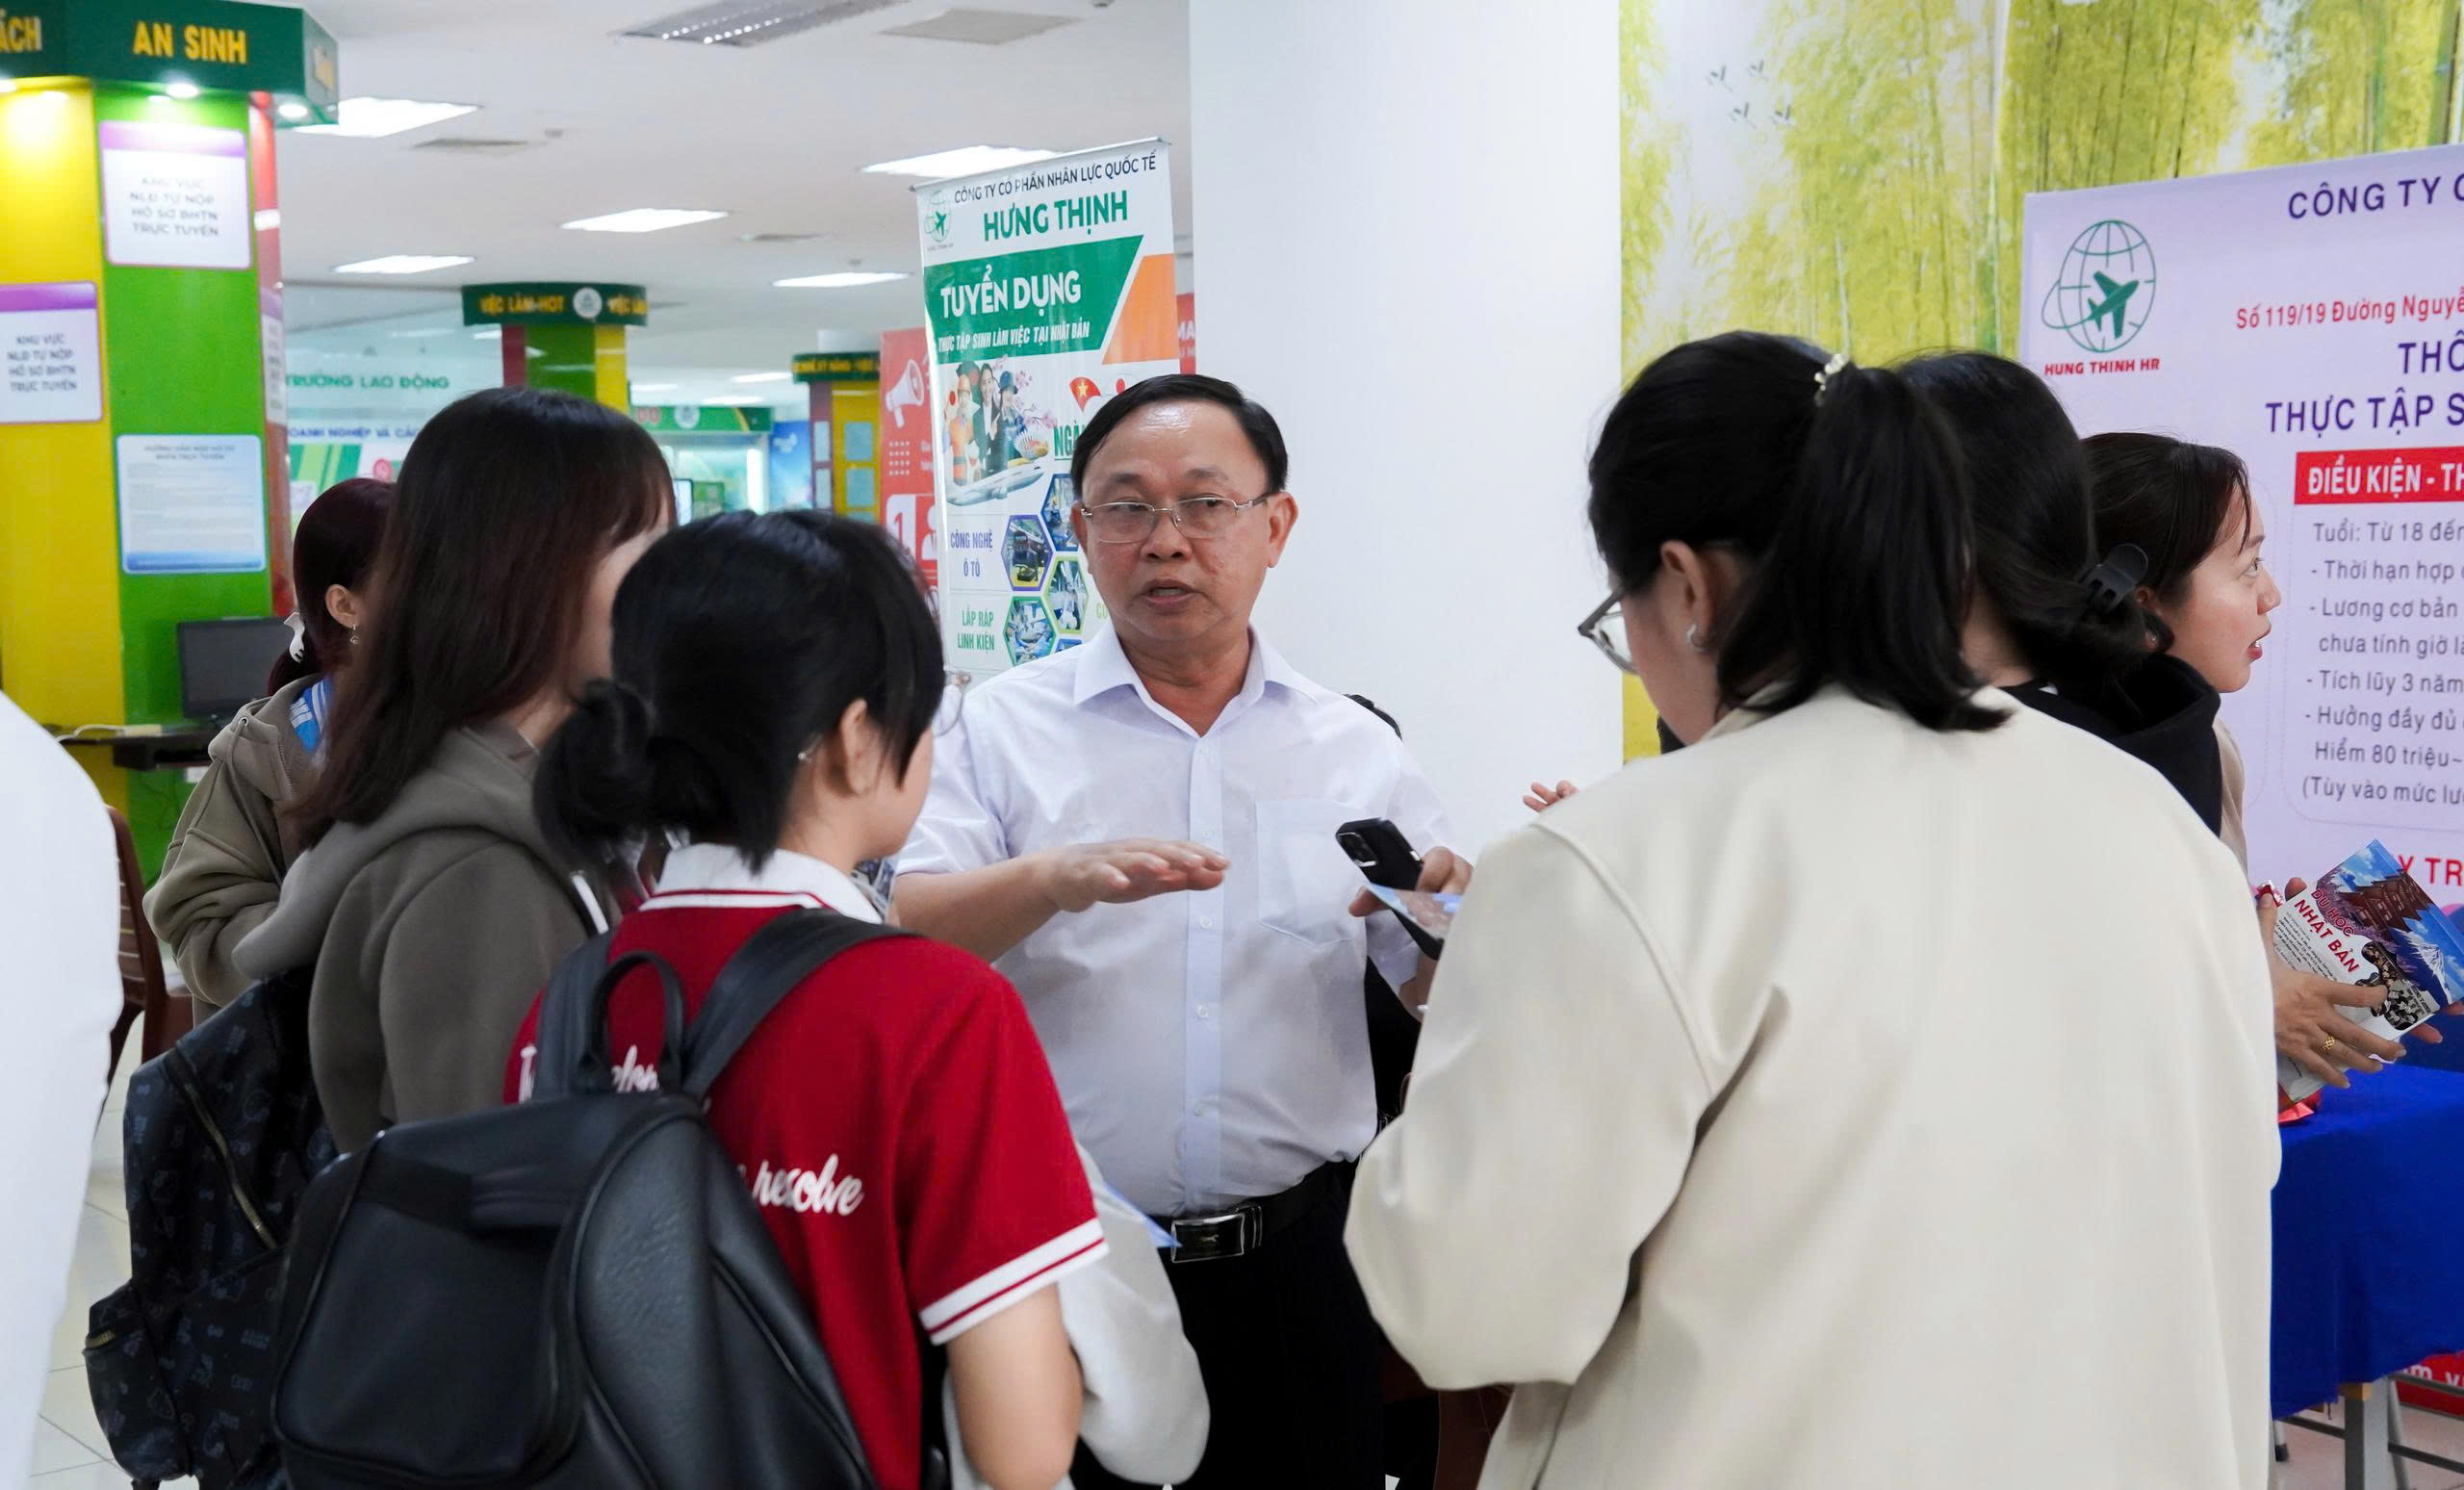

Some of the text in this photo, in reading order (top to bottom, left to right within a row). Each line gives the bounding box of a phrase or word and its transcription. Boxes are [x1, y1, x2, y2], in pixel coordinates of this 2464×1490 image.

[133, 19, 247, 64] AN SINH
[954, 185, 982, 204] CÔNG
[984, 184, 996, 198] TY
[1047, 166, 1078, 188] NHÂN
[1081, 163, 1103, 185] LỰC
[1105, 154, 1140, 179] QUỐC
[1142, 149, 1156, 170] TẾ
[2288, 181, 2385, 219] CÔNG
[2398, 176, 2442, 207] TY
[984, 190, 1128, 242] HƯNG THỊNH
[940, 263, 1081, 319] TUYỂN DỤNG
[2236, 303, 2261, 330] Số
[2266, 302, 2326, 327] 119/19
[2331, 297, 2397, 324] Đường
[956, 331, 971, 352] TẬP
[972, 331, 991, 348] SINH
[992, 327, 1008, 347] LÀM
[1010, 324, 1030, 347] VIỆC
[1033, 325, 1048, 347] TẠI
[1050, 321, 1070, 345] NHẬT
[1071, 317, 1091, 338] BẢN
[2398, 329, 2464, 374] THÔ
[2044, 357, 2161, 376] HUNG THINH HR
[361, 374, 394, 389] LAO
[399, 371, 450, 393] ĐỘNG
[2265, 395, 2355, 439] THỰC
[2367, 387, 2434, 436] TẬP
[288, 426, 324, 439] OANH
[1053, 419, 1085, 456] NGÀ
[2366, 456, 2423, 500] KIỆN
[950, 528, 993, 552] CÔNG NGHỆ
[2313, 517, 2361, 543] Tuổi:
[2368, 520, 2394, 542] Từ
[2401, 522, 2425, 542] 18
[962, 557, 981, 578] Ô TÔ
[2324, 558, 2369, 579] Thời
[2373, 559, 2410, 583] hạn
[2417, 559, 2455, 585] hợp
[979, 606, 994, 627] RÁP
[2322, 597, 2384, 623] Lương
[2390, 600, 2415, 618] cơ
[2420, 595, 2458, 619] bản
[958, 630, 995, 655] LINH KIỆN
[2319, 632, 2367, 654] chưa
[2373, 633, 2410, 655] tính
[2417, 634, 2449, 660] giờ
[2320, 669, 2360, 690] Tích
[2367, 671, 2396, 697] lũy
[2402, 673, 2414, 692] 3
[2421, 674, 2464, 694] năm
[2318, 705, 2382, 732] Hưởng
[2431, 707, 2456, 731] đủ
[2315, 737, 2366, 762] Hiểm
[2372, 744, 2397, 764] 80
[2302, 775, 2464, 805] (Tùy vào mức lư
[2311, 887, 2331, 908] DU
[2294, 898, 2334, 939] NHẬT
[2327, 938, 2360, 973] BẢN
